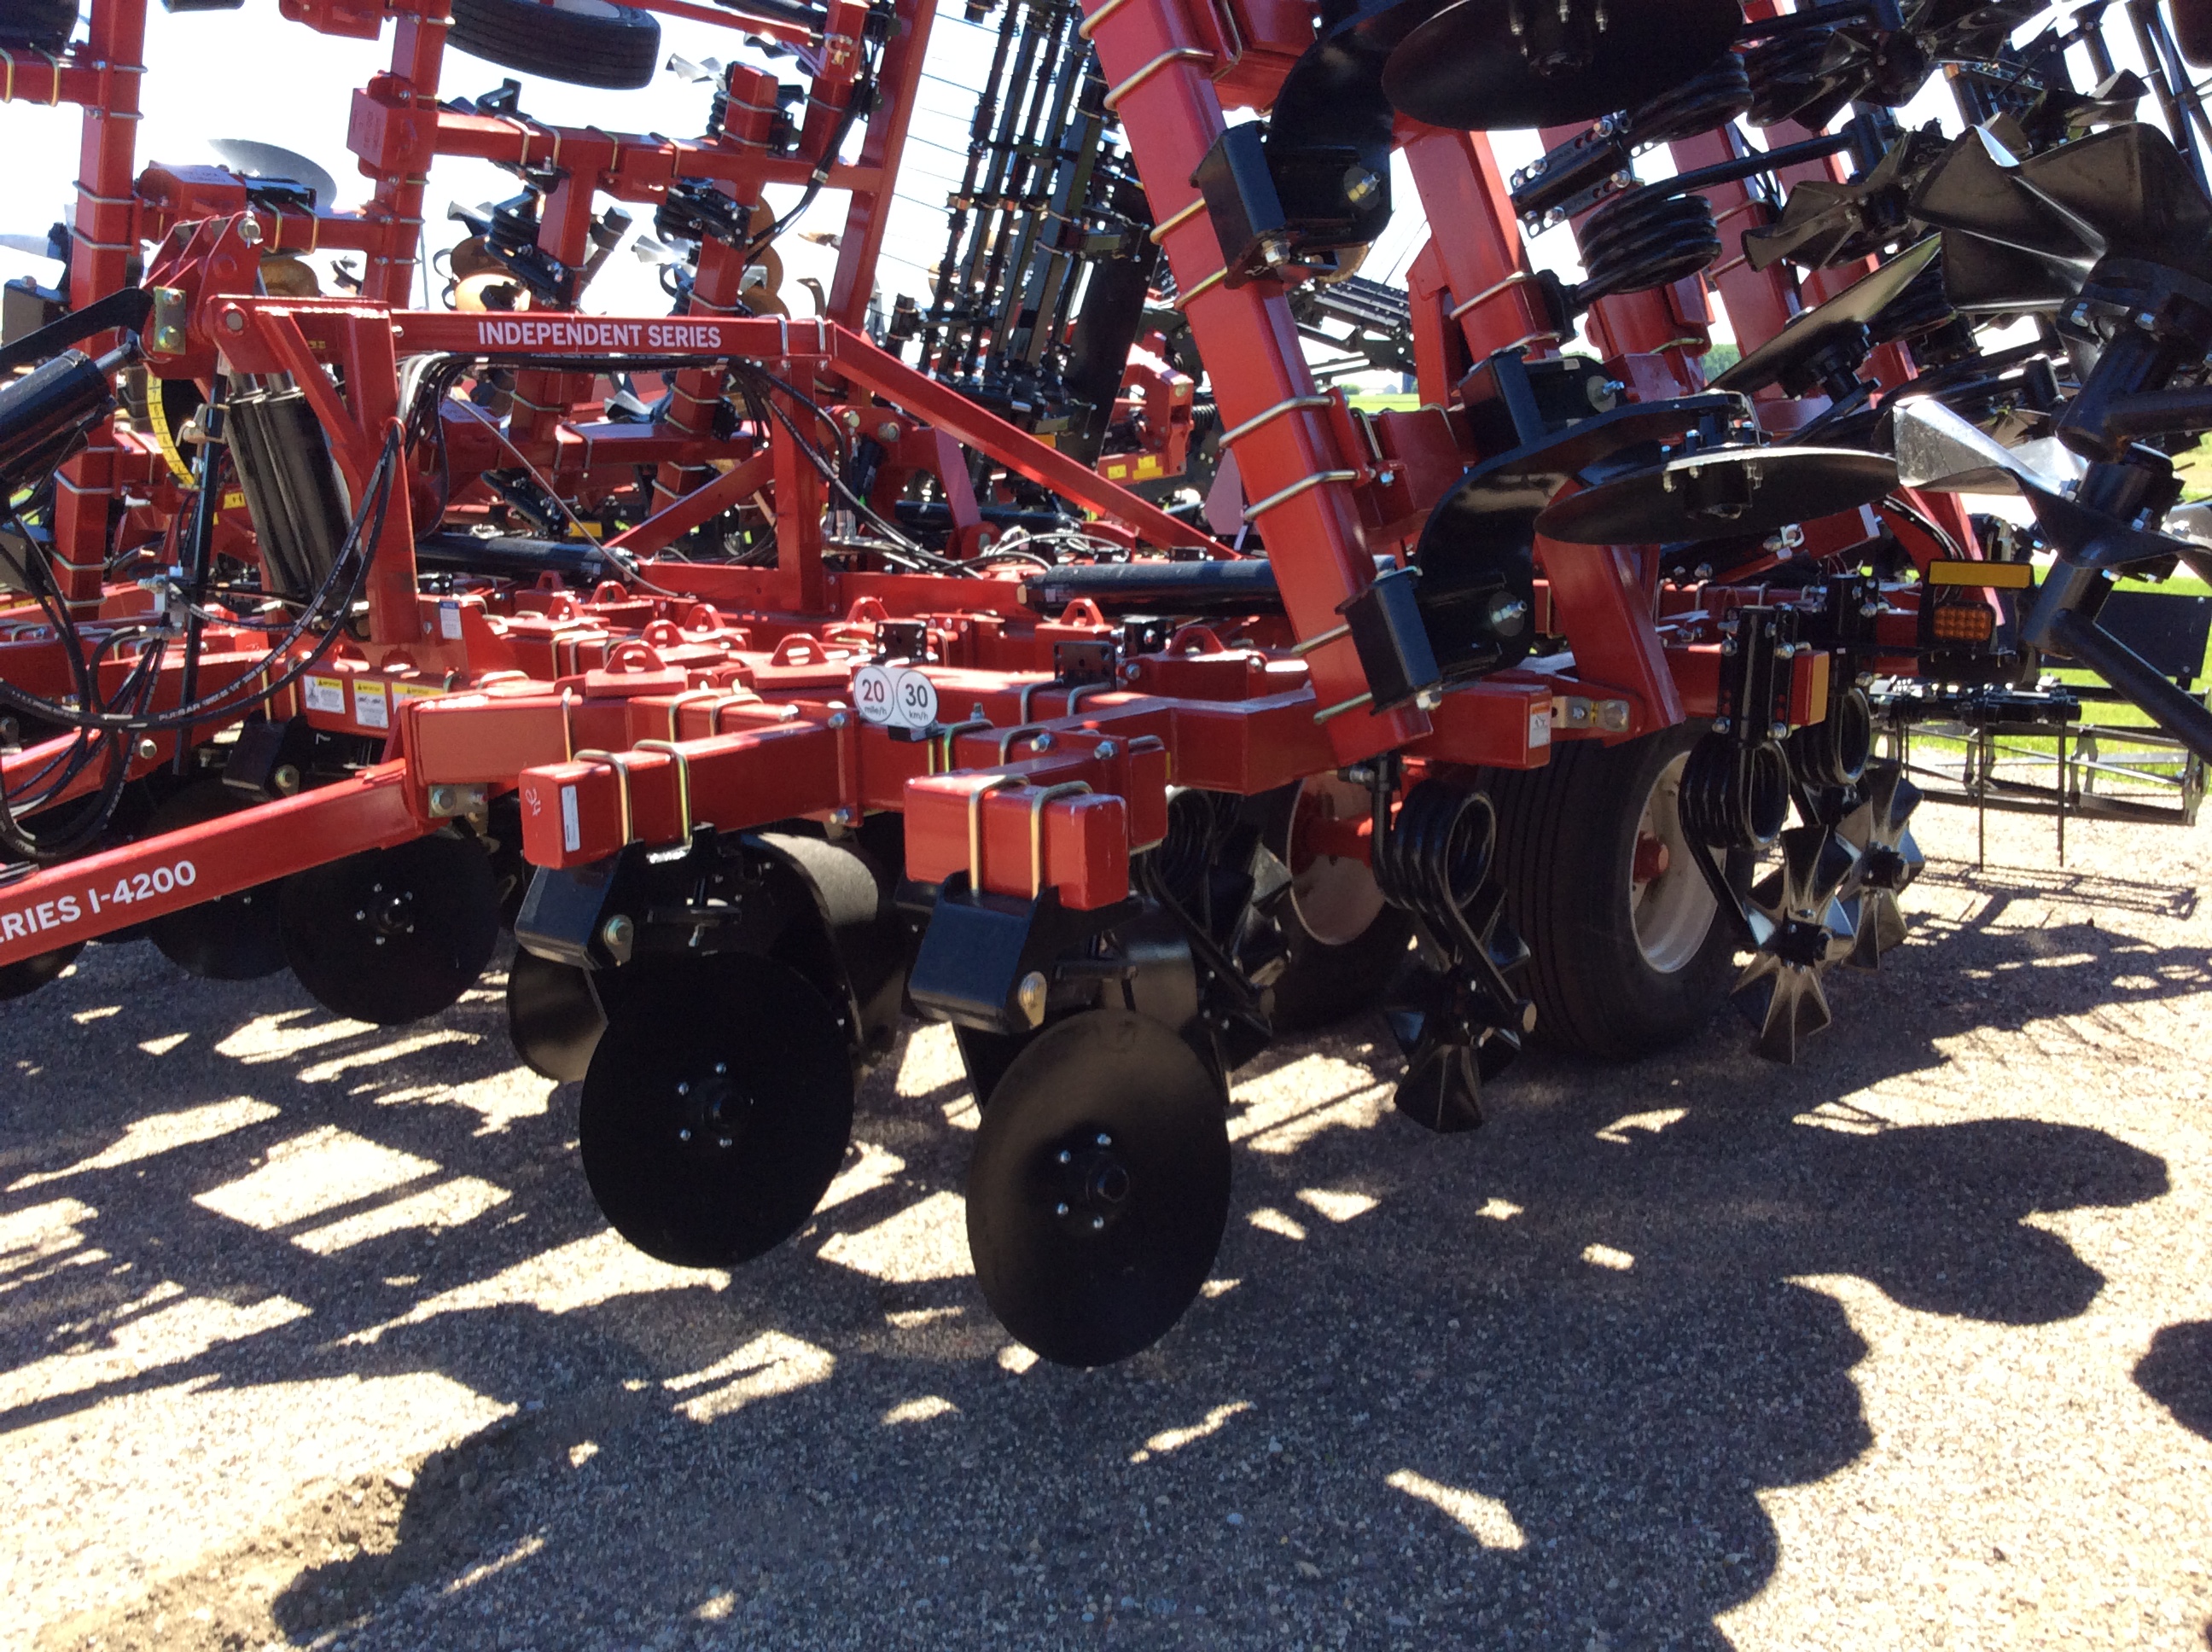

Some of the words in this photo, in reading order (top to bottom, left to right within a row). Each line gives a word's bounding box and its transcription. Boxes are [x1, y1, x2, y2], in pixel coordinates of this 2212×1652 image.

[478, 321, 643, 346] INDEPENDENT
[649, 325, 721, 348] SERIES
[862, 678, 885, 703] 20
[905, 683, 928, 708] 30
[864, 706, 888, 716] mile/h
[909, 710, 929, 720] km/h
[0, 896, 82, 944] RIES
[89, 860, 196, 914] I-4200
